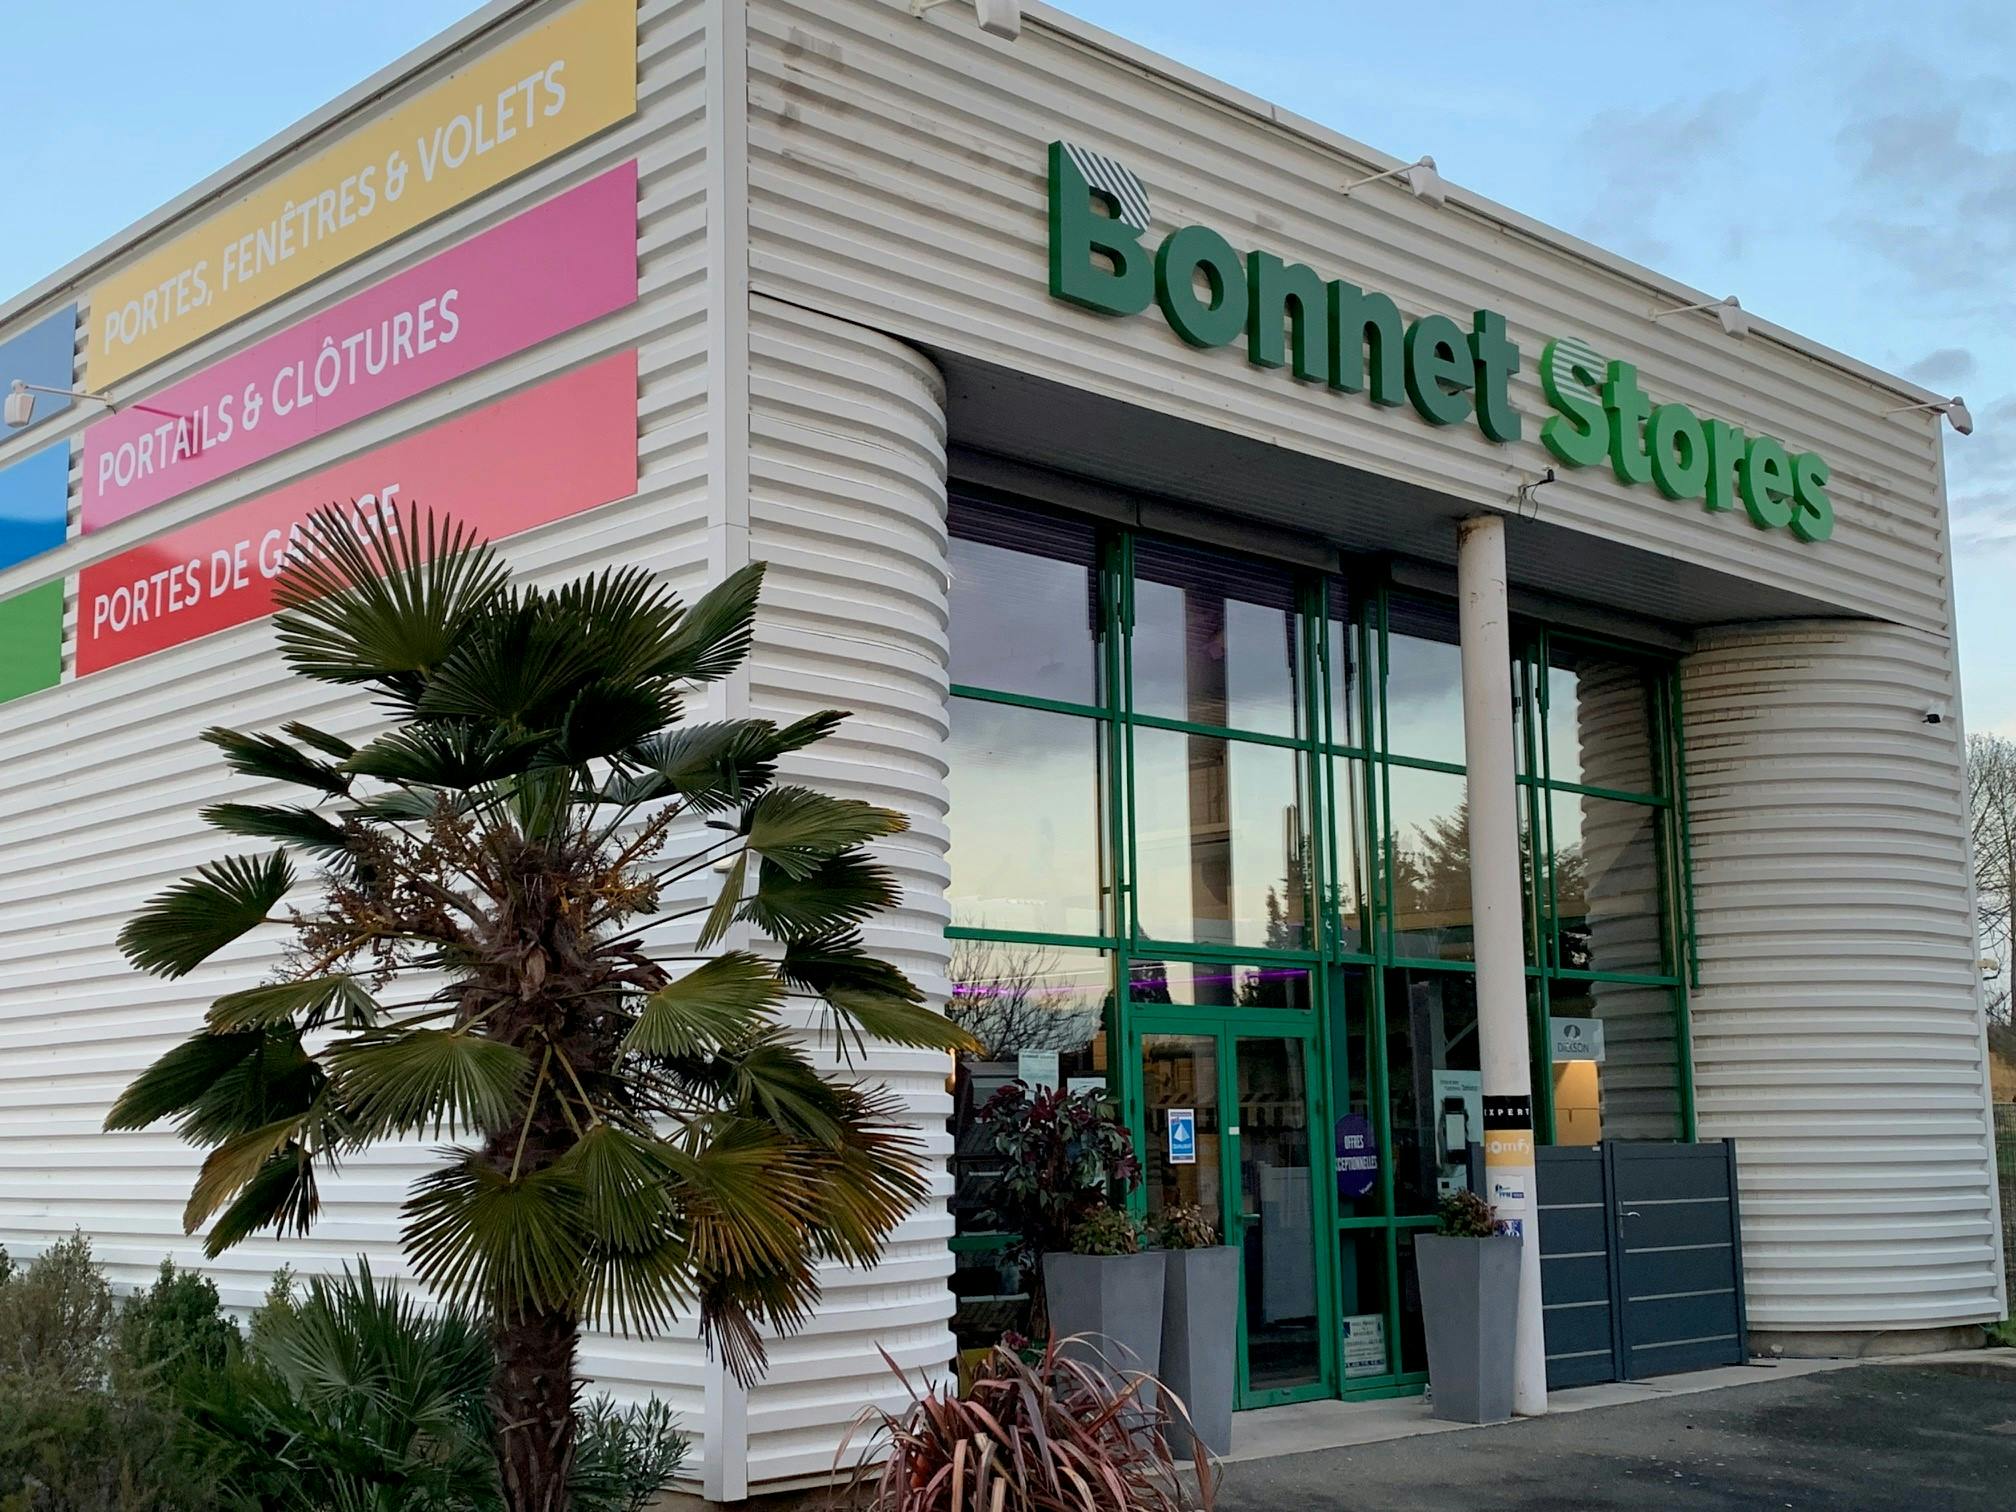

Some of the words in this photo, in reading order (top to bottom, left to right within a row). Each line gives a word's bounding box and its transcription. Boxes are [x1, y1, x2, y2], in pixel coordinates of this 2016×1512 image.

[104, 260, 213, 355] PORTES,
[222, 166, 376, 291] FENÊTRES
[384, 151, 409, 202] &
[417, 60, 567, 183] VOLETS
[98, 394, 234, 496] PORTAILS
[242, 382, 263, 431] &
[272, 288, 460, 416] CLÔTURES
[1048, 140, 1522, 444] Bonnet
[1539, 336, 1835, 543] Stores
[93, 558, 201, 640] PORTES
[209, 539, 250, 599] DE
